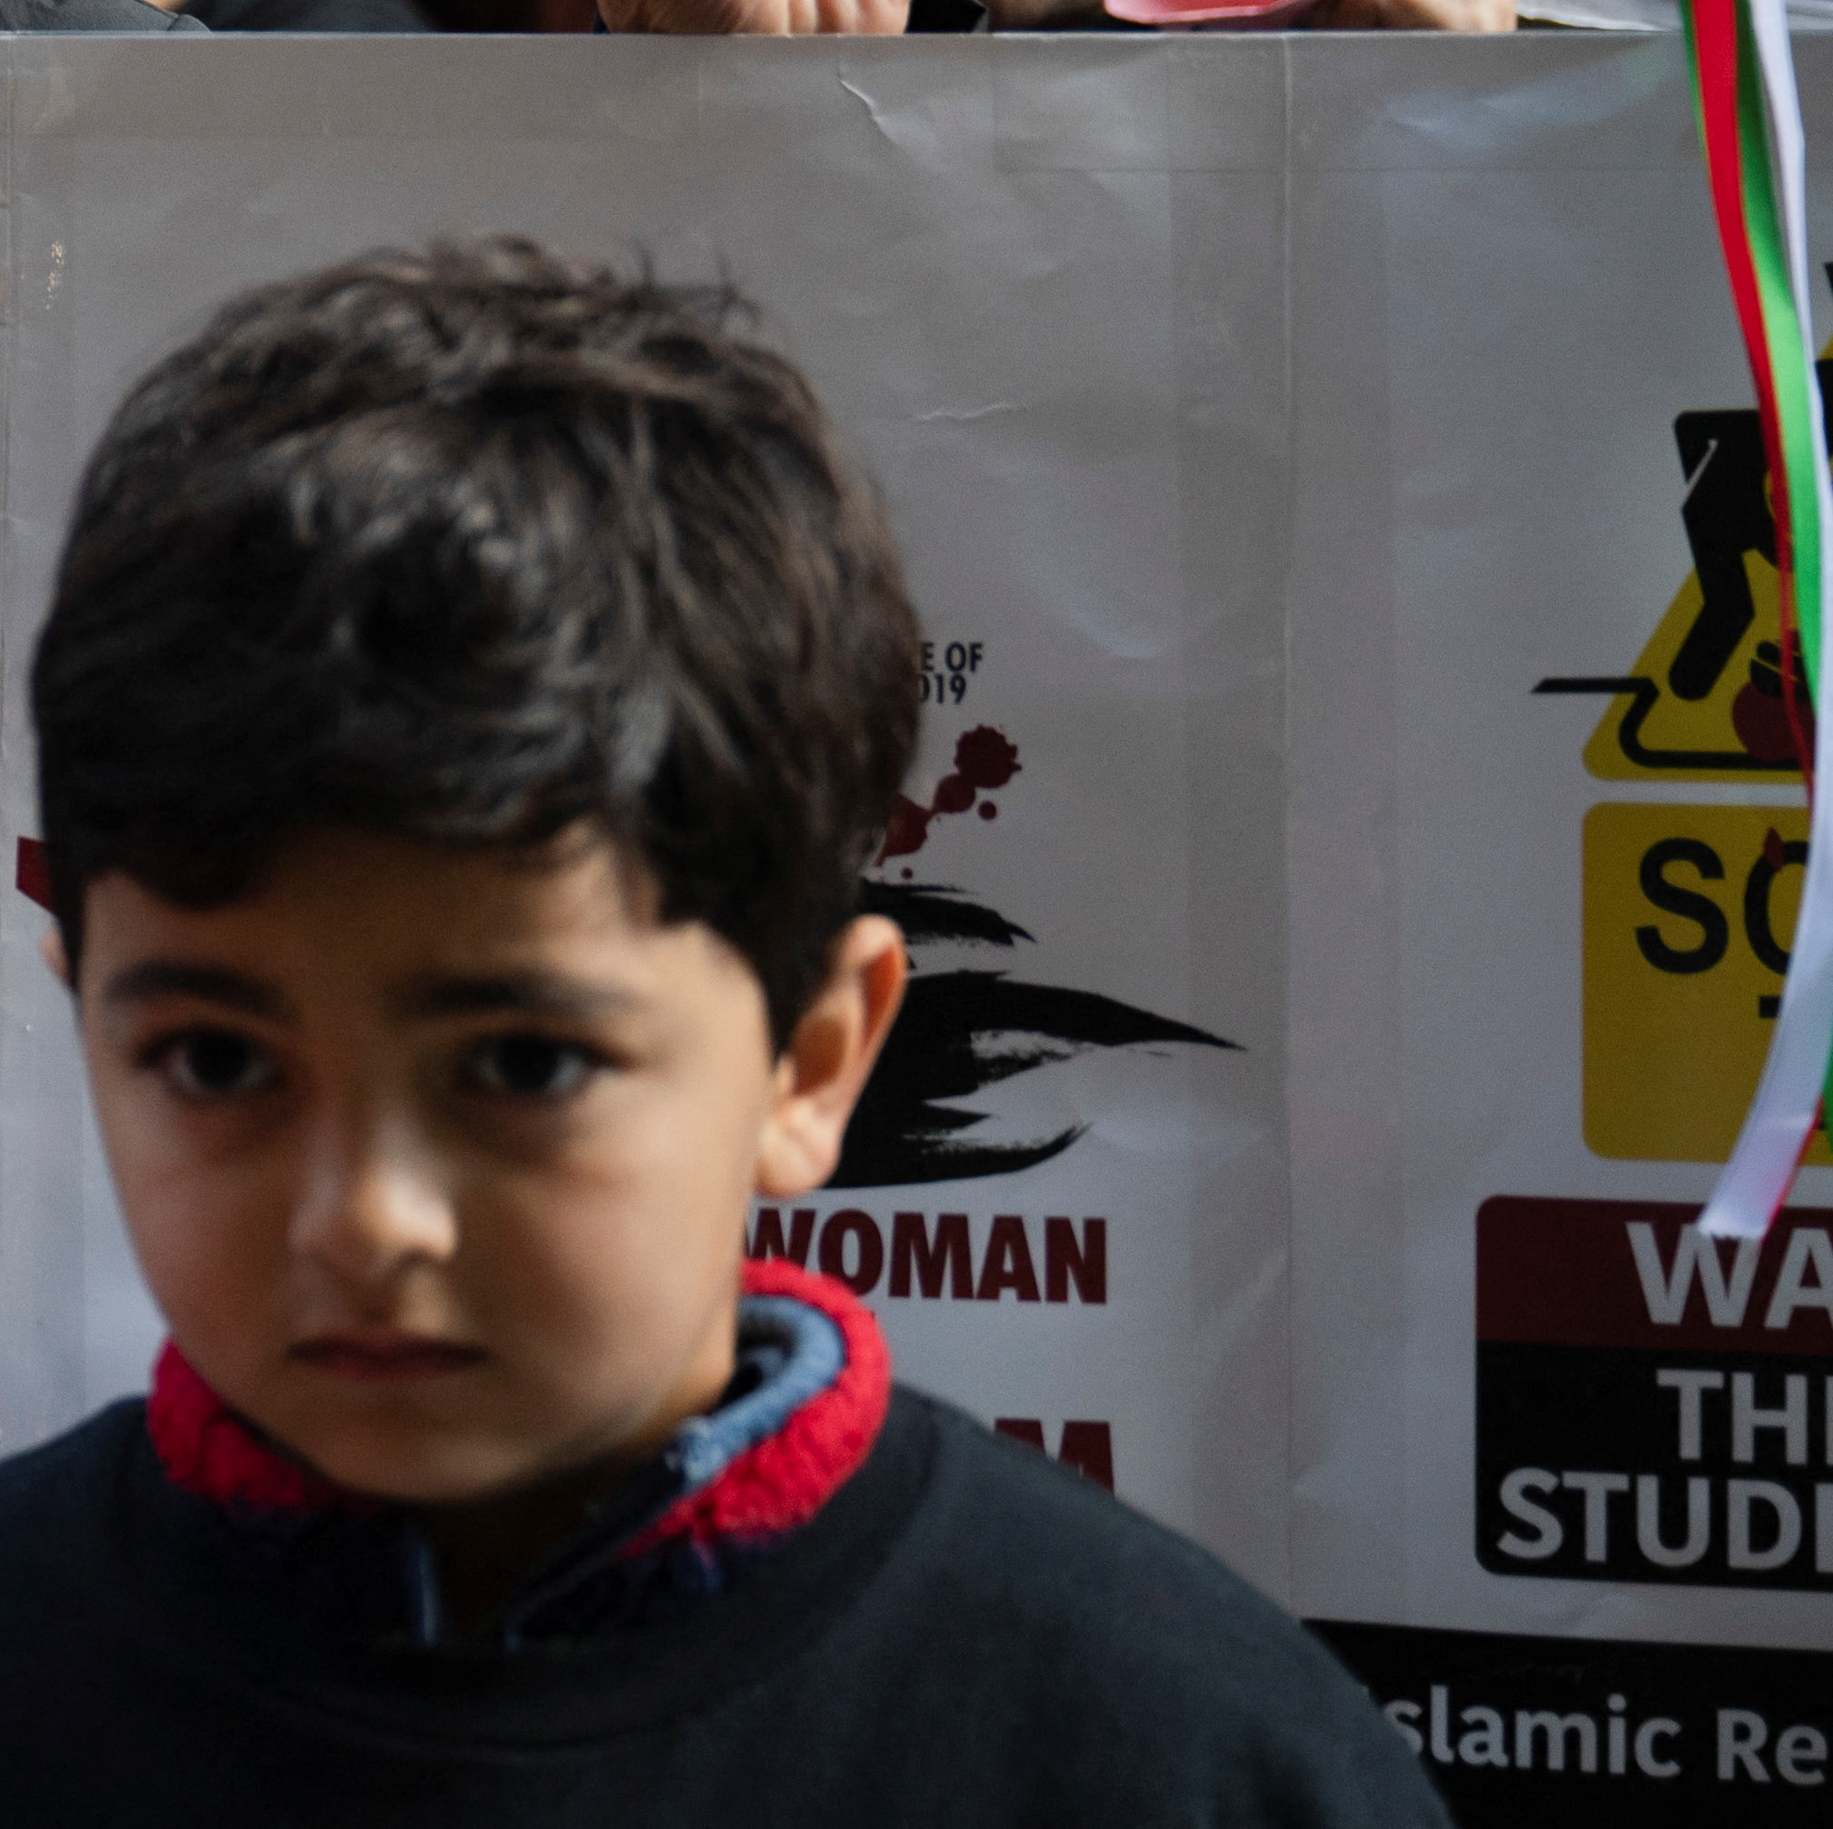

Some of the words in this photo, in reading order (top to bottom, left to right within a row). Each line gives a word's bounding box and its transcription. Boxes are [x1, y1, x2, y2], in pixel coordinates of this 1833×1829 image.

[945, 641, 984, 673] OF
[745, 1207, 1106, 1305] WOMAN
[1657, 1369, 1833, 1467] TH
[1378, 1684, 1682, 1779] slamic
[1716, 1708, 1829, 1787] Re
